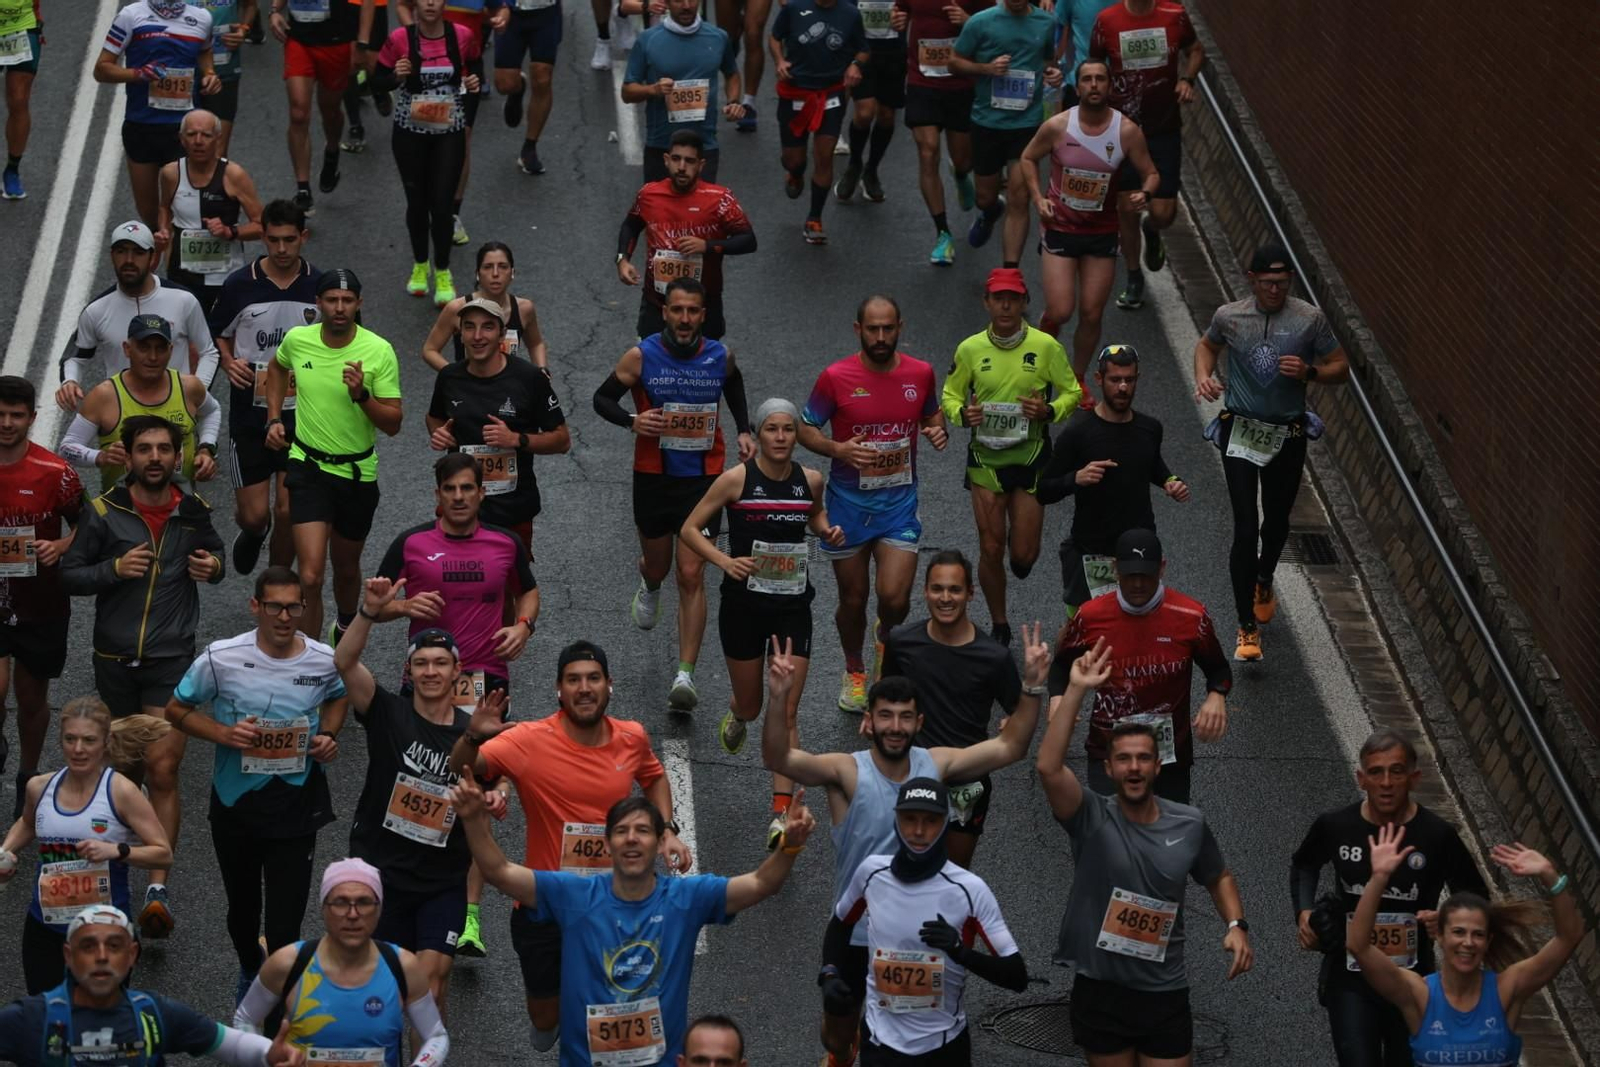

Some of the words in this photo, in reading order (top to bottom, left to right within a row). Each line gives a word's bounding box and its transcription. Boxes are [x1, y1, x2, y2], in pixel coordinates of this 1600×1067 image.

[2, 39, 18, 51] 97
[1127, 39, 1157, 54] 6933
[672, 91, 702, 103] 3895
[1067, 177, 1098, 195] 6067
[188, 241, 221, 255] 6732
[660, 261, 690, 277] 3816
[256, 328, 288, 350] Quil
[648, 377, 675, 386] JOSEP
[677, 377, 722, 387] CARRERAS
[671, 416, 704, 430] 5435
[986, 414, 1017, 430] 7790
[1240, 424, 1273, 446] 7125
[480, 458, 503, 473] 794
[1, 540, 20, 554] 54
[760, 554, 795, 571] 7786
[1092, 565, 1110, 579] 72
[451, 680, 470, 696] 12
[906, 789, 937, 800] HOKA
[400, 791, 443, 818] 4537
[572, 839, 608, 857] 462
[1339, 845, 1363, 862] 68
[49, 876, 92, 897] 3510
[1116, 907, 1160, 933] 4863
[1369, 929, 1401, 945] 935
[882, 966, 926, 987] 4672
[599, 1018, 645, 1041] 5173
[1424, 1048, 1506, 1063] CREDUS
